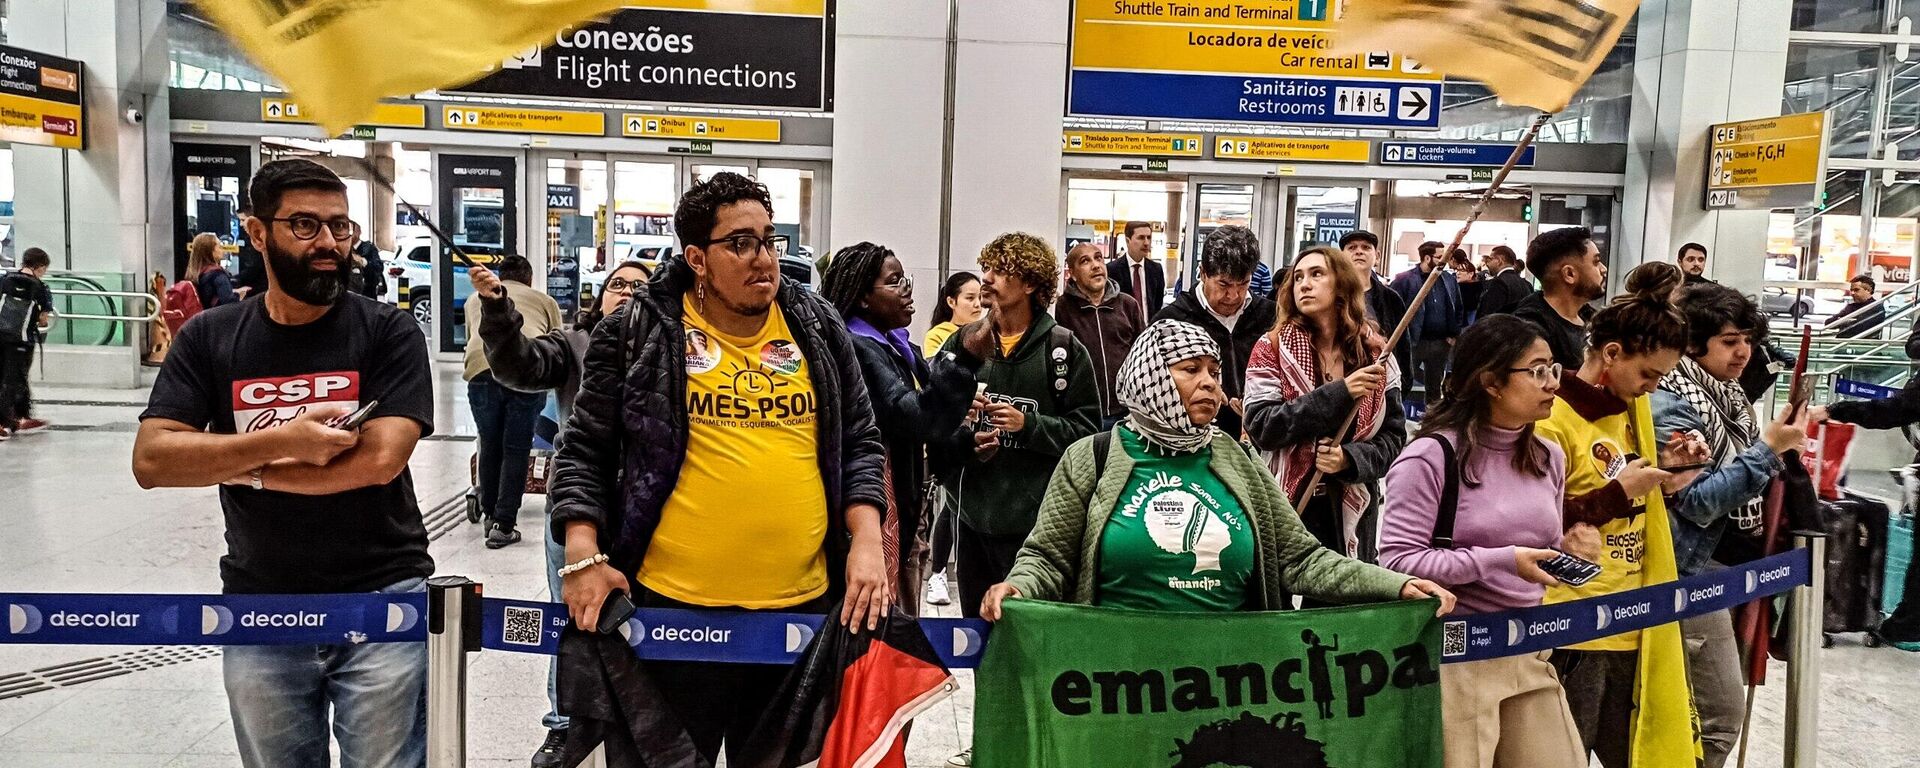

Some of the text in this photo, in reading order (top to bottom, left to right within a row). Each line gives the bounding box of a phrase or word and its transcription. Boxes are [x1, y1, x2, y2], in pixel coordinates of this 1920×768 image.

[1114, 1, 1292, 20] Shuttle Train and Terminal
[555, 25, 694, 53] Conexões
[1188, 31, 1335, 49] Locadora de veícu
[1, 52, 36, 69] Conexões
[1281, 53, 1358, 69] Car rental
[1, 66, 18, 78] Flight
[557, 56, 797, 89] Flight connections
[0, 80, 37, 92] connections
[68, 75, 74, 89] 2
[1243, 80, 1326, 97] Sanitários
[1, 107, 36, 120] Embarque
[1239, 99, 1325, 116] Restrooms
[528, 114, 562, 122] transporte
[661, 118, 686, 126] Ônibus
[43, 120, 67, 132] Terminal
[68, 121, 74, 135] 3
[355, 129, 375, 138] SAÍDA
[692, 143, 711, 151] SAÍDA
[1175, 140, 1181, 150] 1
[1251, 141, 1286, 149] Aplicativos
[1296, 143, 1329, 151] transporte
[1419, 146, 1476, 154] Guarda-volumes
[1757, 144, 1786, 162] F,G,H
[1148, 160, 1167, 168] SAÍDA
[1472, 170, 1492, 179] SAÍDA
[240, 375, 351, 404] CSP
[689, 391, 817, 419] MES-PSOL
[688, 416, 737, 427] MOVIMENTO
[740, 421, 780, 429] ESQUERDA
[1122, 471, 1242, 531] Marielle Somos Nós
[1759, 565, 1791, 584] decolar
[1690, 583, 1724, 602] decolar
[1614, 600, 1651, 620] decolar
[50, 611, 140, 628] decolar
[240, 611, 327, 628] decolar
[1529, 617, 1571, 636] decolar
[652, 625, 732, 643] decolar
[1472, 626, 1488, 635] Baixe
[1476, 636, 1492, 647] App!
[1051, 630, 1440, 719] emancipa
